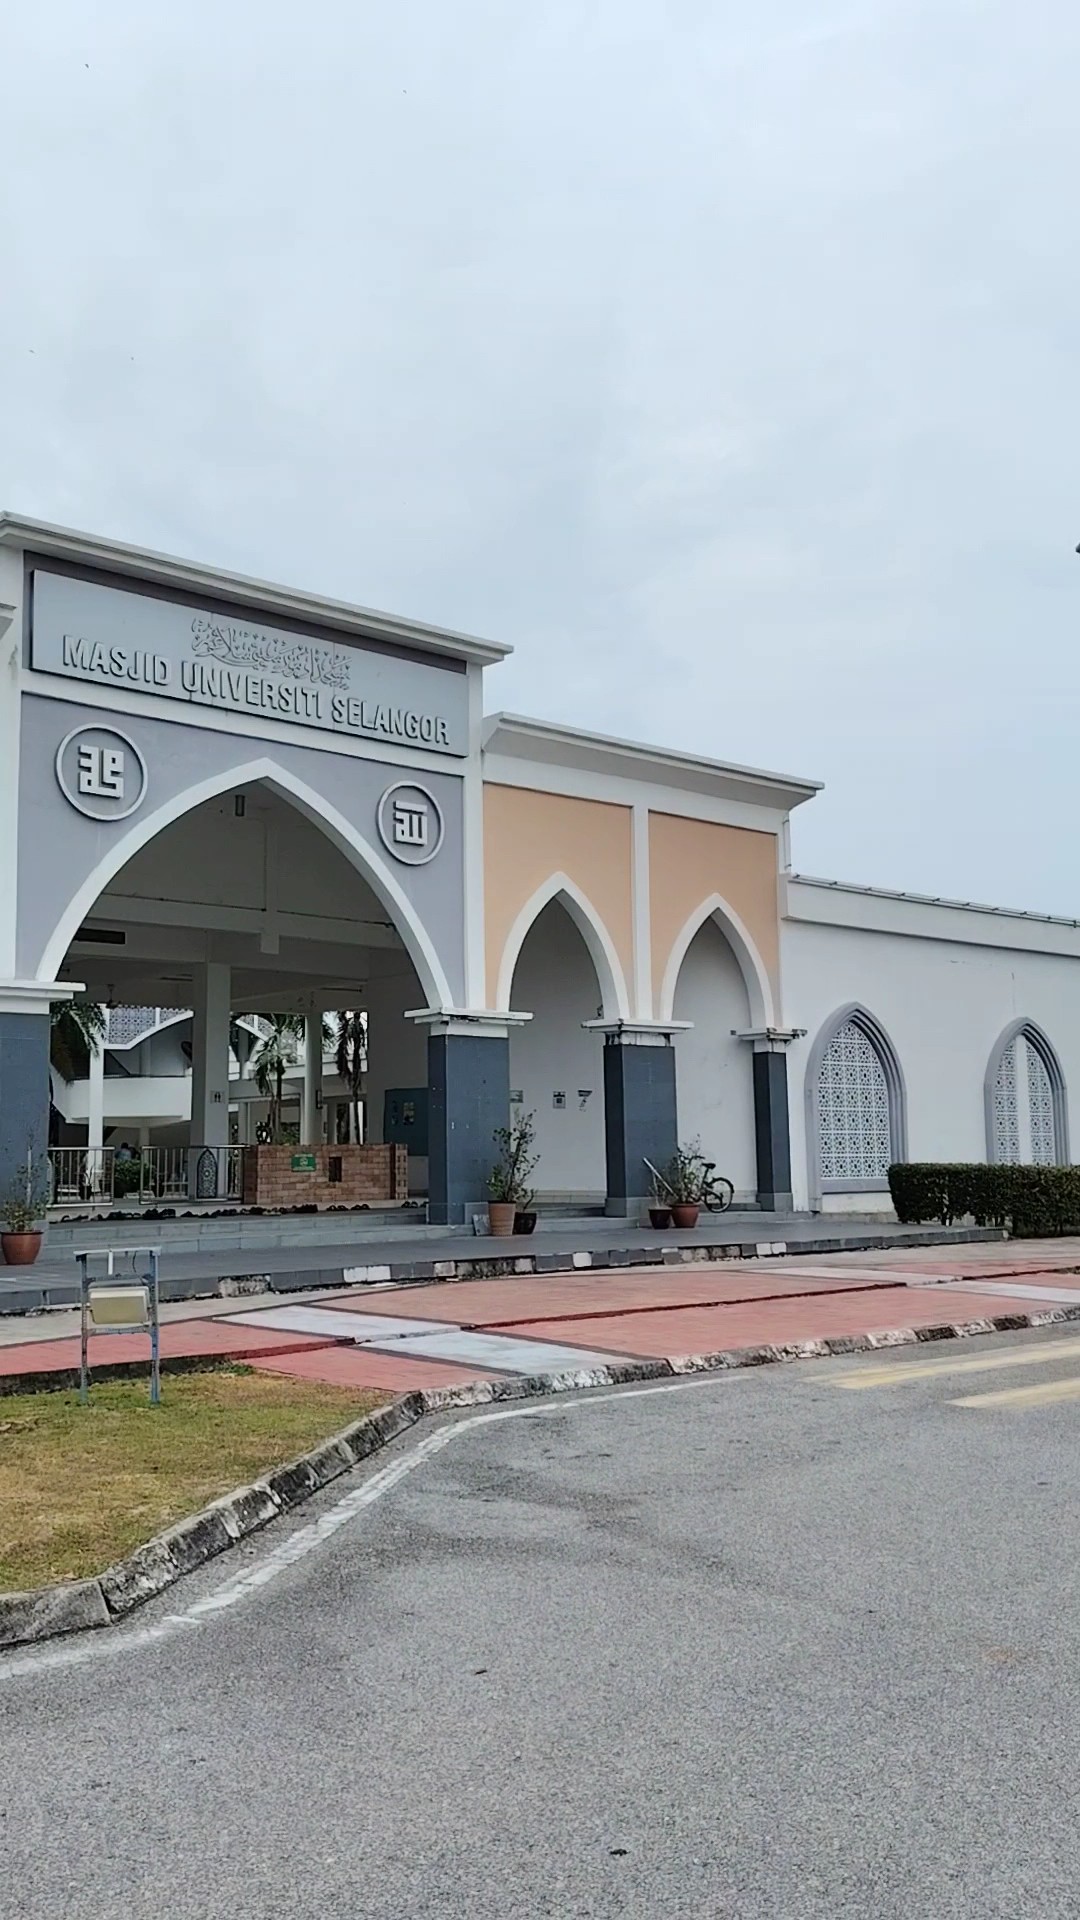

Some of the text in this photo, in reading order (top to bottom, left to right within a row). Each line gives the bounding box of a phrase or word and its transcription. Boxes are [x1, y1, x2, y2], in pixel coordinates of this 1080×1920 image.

[63, 635, 171, 686] MASJID
[182, 660, 322, 719] UNIVERSITI
[331, 694, 450, 745] SELANGOR
